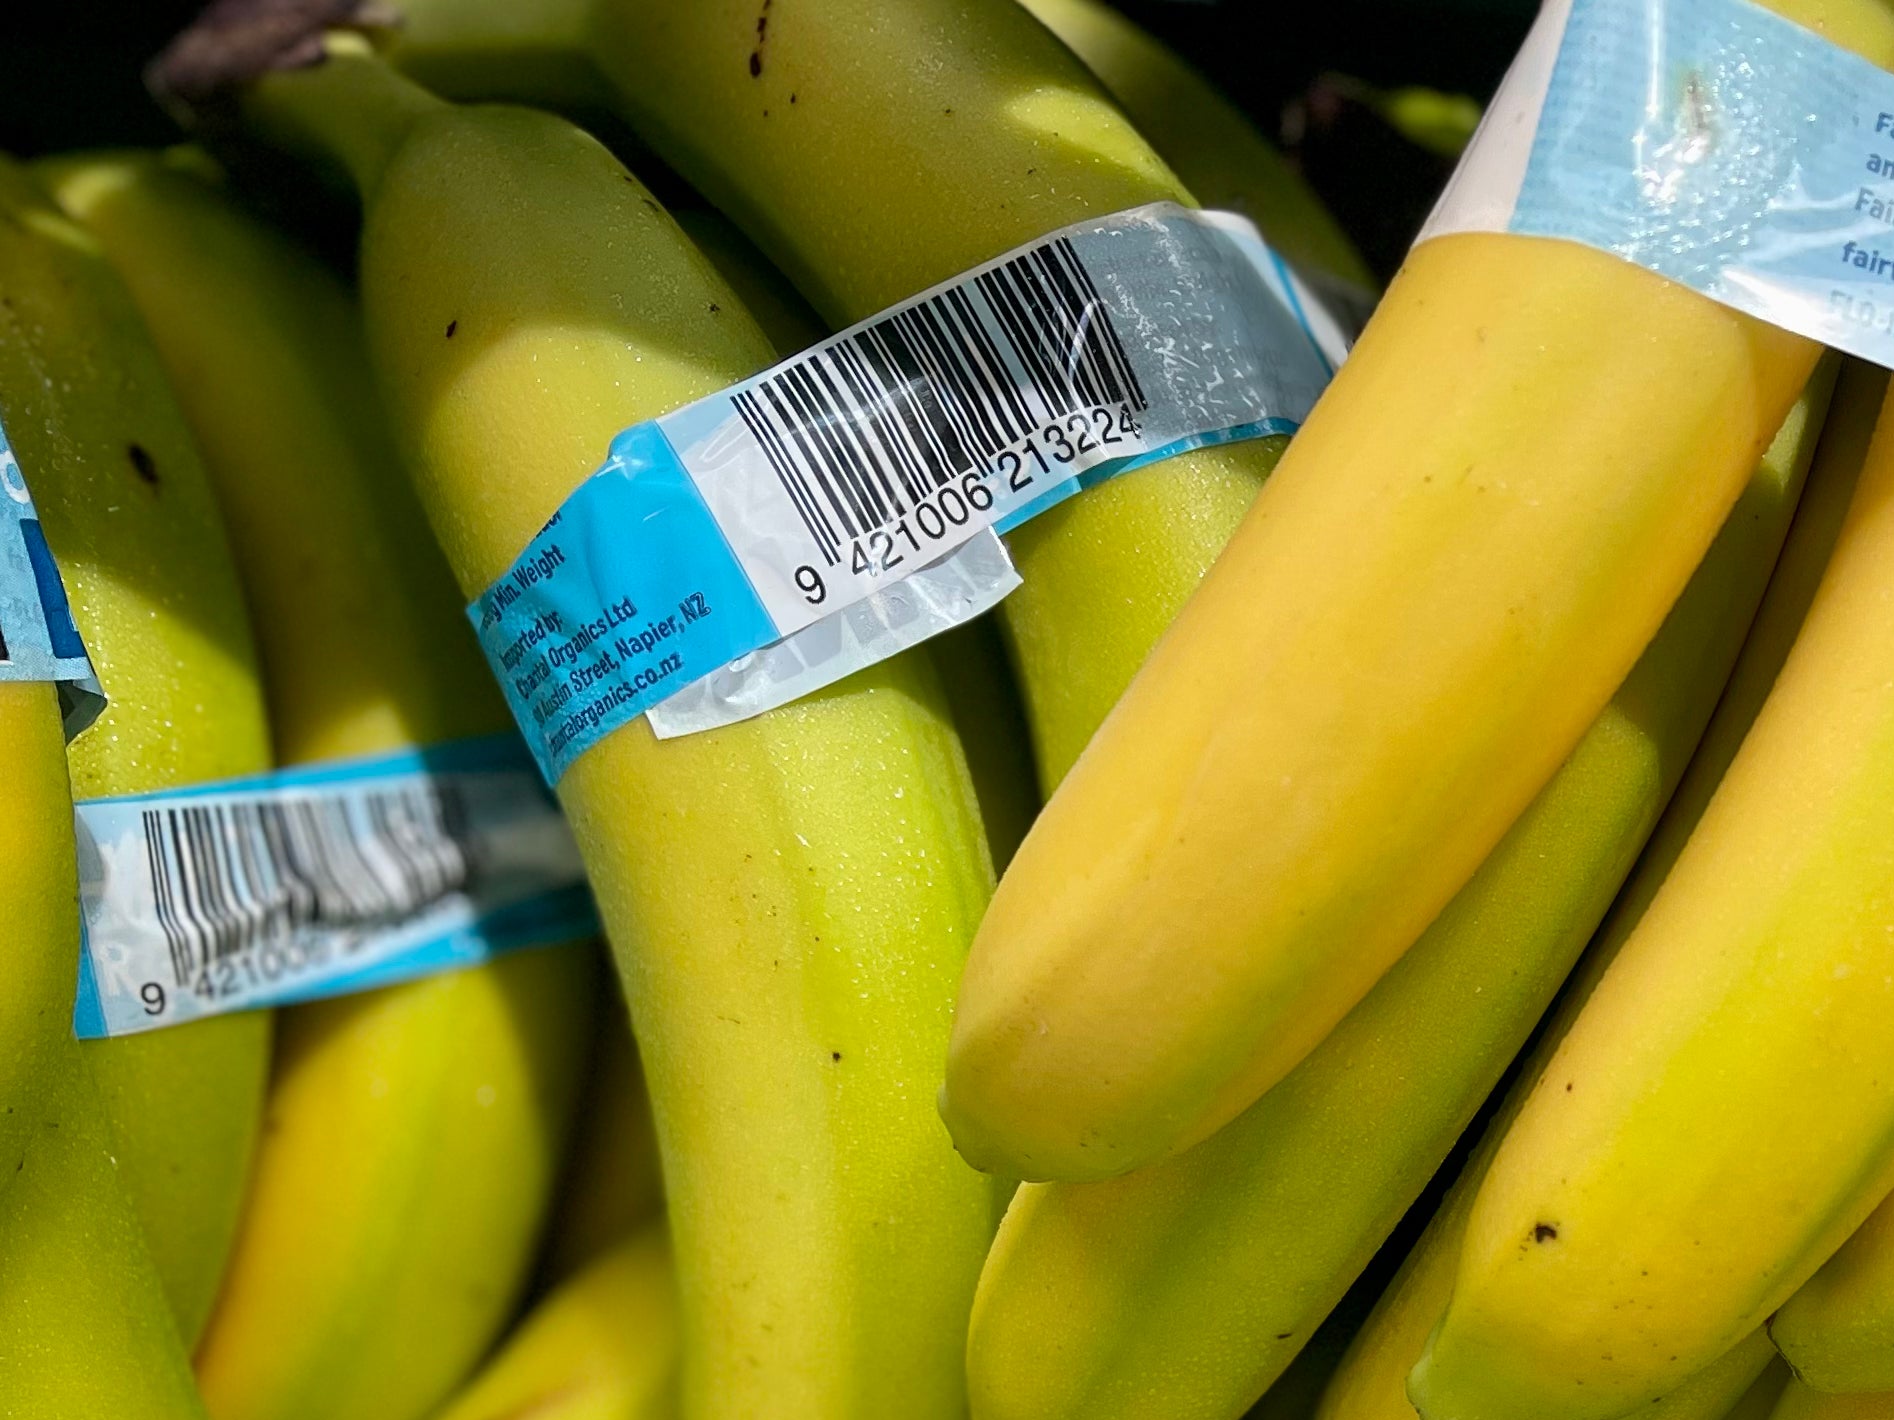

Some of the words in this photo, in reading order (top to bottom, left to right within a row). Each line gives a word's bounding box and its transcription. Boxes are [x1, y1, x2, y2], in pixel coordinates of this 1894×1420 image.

[794, 564, 828, 605] 9
[850, 471, 994, 579] 421006
[997, 403, 1143, 494] 213224
[494, 581, 520, 613] Min.
[512, 543, 566, 597] Weight
[547, 615, 608, 668] Organics
[603, 595, 638, 628] Ltd
[569, 651, 621, 694] Street,
[614, 614, 686, 662] Napier,
[679, 591, 712, 626] NZ
